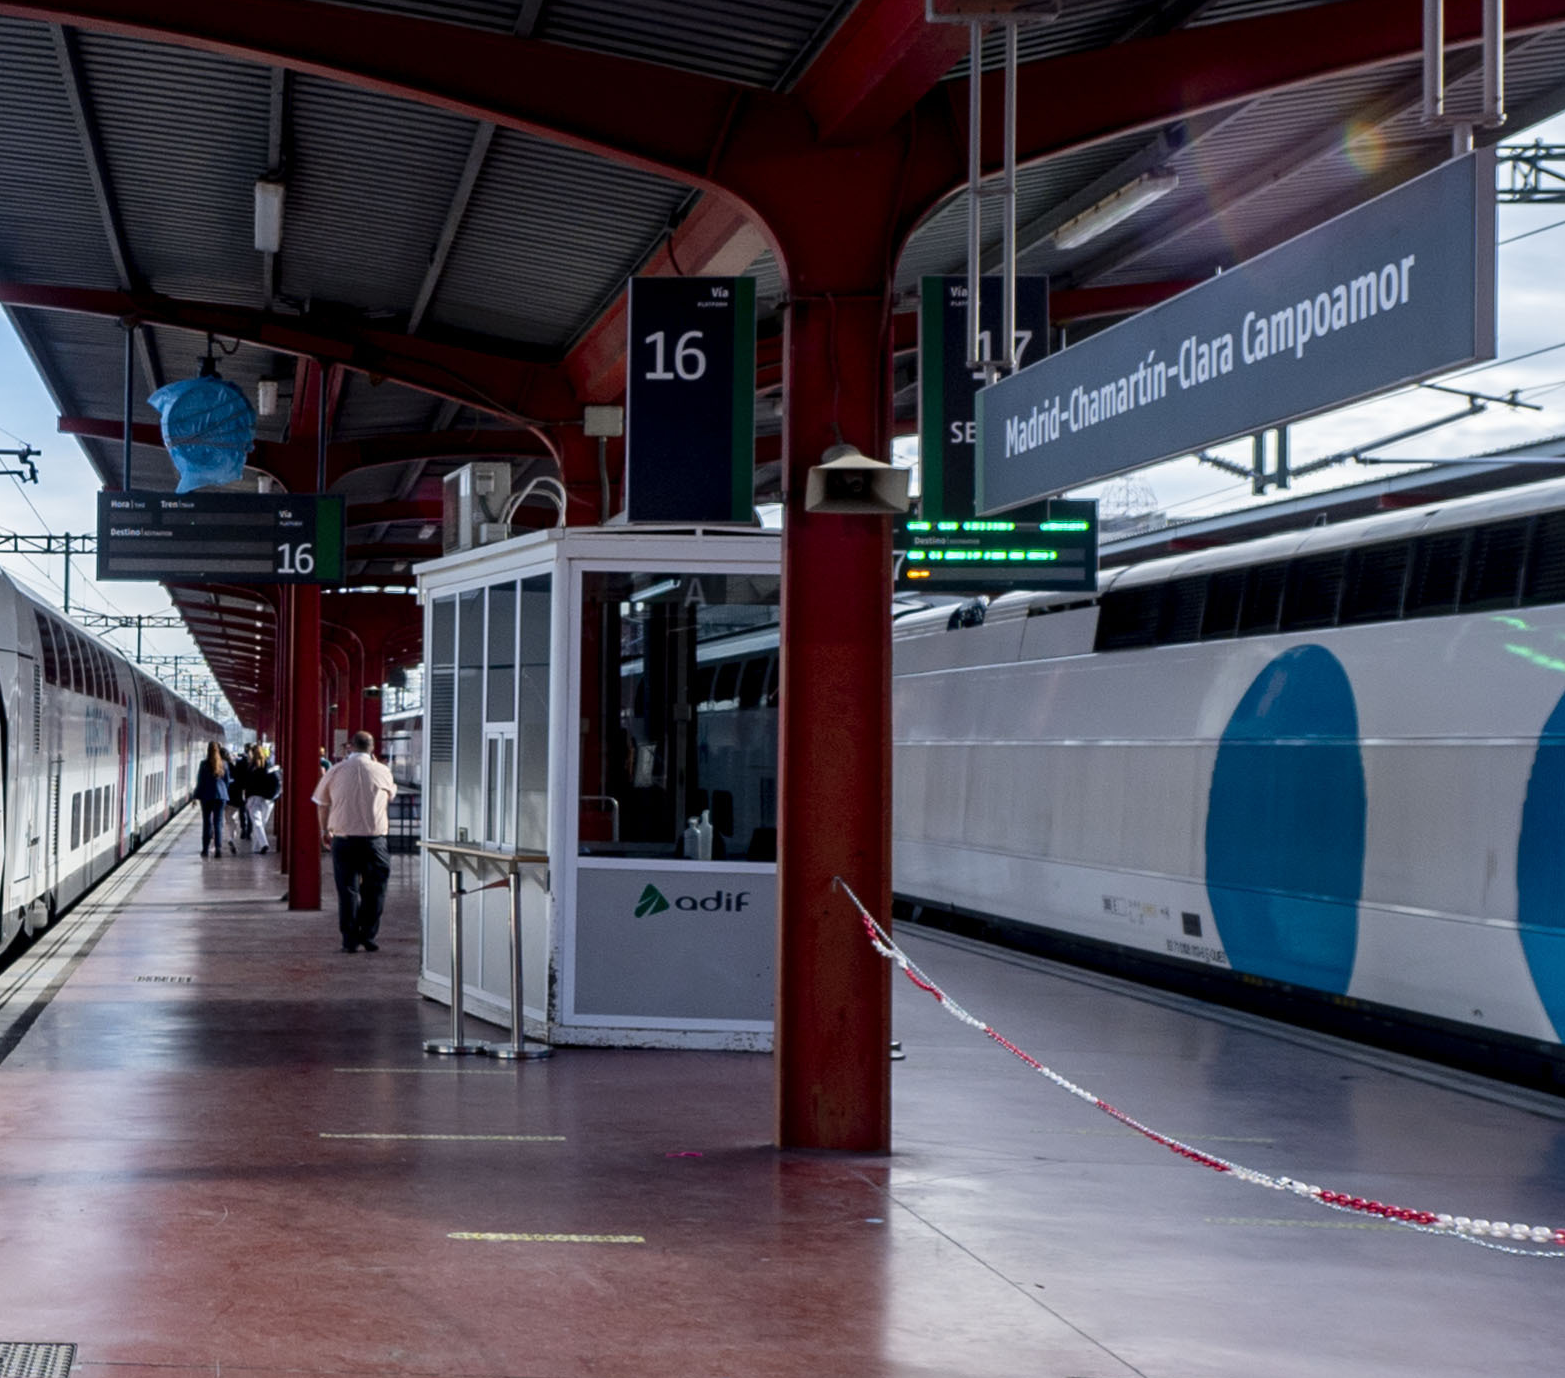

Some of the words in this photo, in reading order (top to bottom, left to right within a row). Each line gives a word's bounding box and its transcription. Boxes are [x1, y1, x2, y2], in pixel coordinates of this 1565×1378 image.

[711, 286, 730, 298] Vía
[1242, 254, 1416, 359] Campoamor
[644, 330, 707, 381] 16
[276, 542, 315, 575] 16
[674, 889, 752, 913] adif
